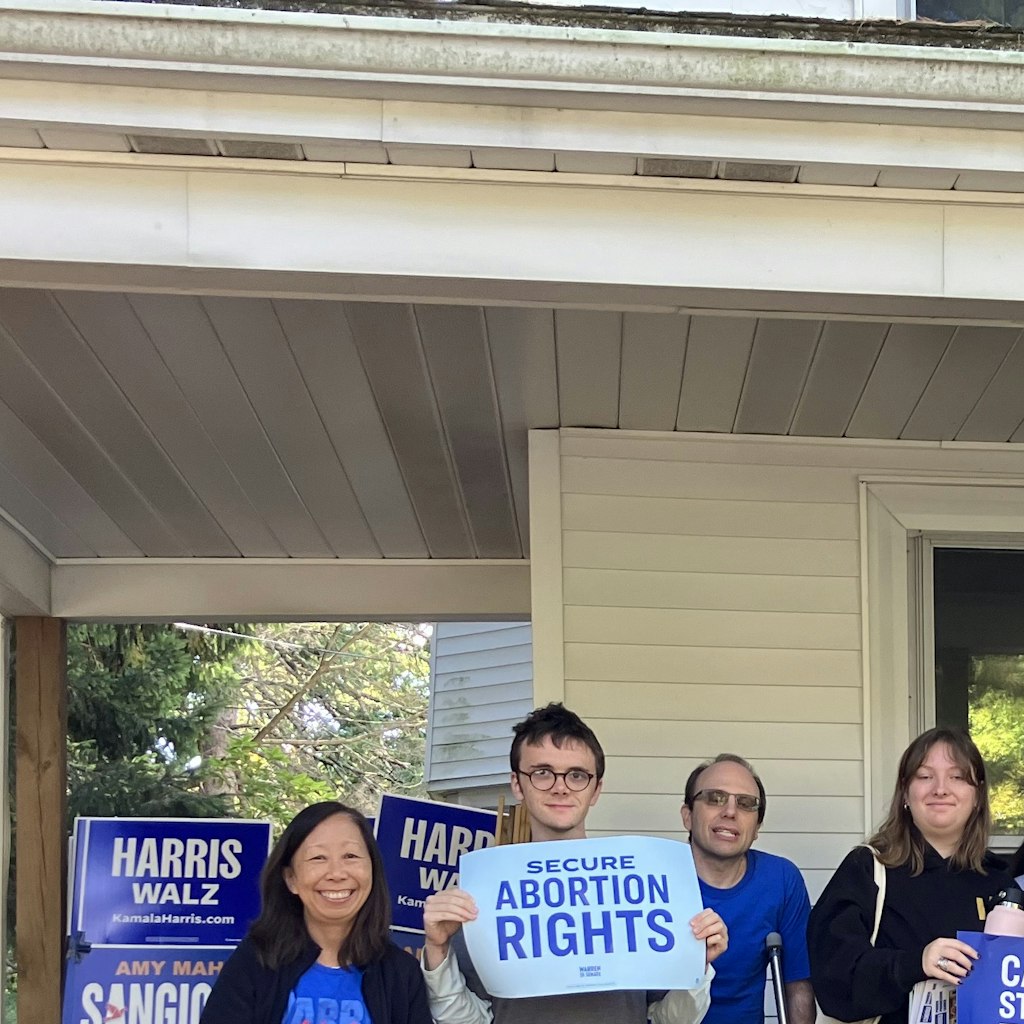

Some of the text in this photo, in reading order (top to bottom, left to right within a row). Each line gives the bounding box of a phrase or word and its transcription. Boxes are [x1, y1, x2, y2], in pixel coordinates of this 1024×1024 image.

[112, 837, 242, 879] HARRIS
[527, 855, 636, 874] SECURE
[132, 882, 220, 905] WALZ
[495, 874, 670, 910] ABORTION
[112, 913, 235, 924] KamalaHarris.com
[496, 909, 675, 961] RIGHTS
[115, 960, 166, 976] AMY
